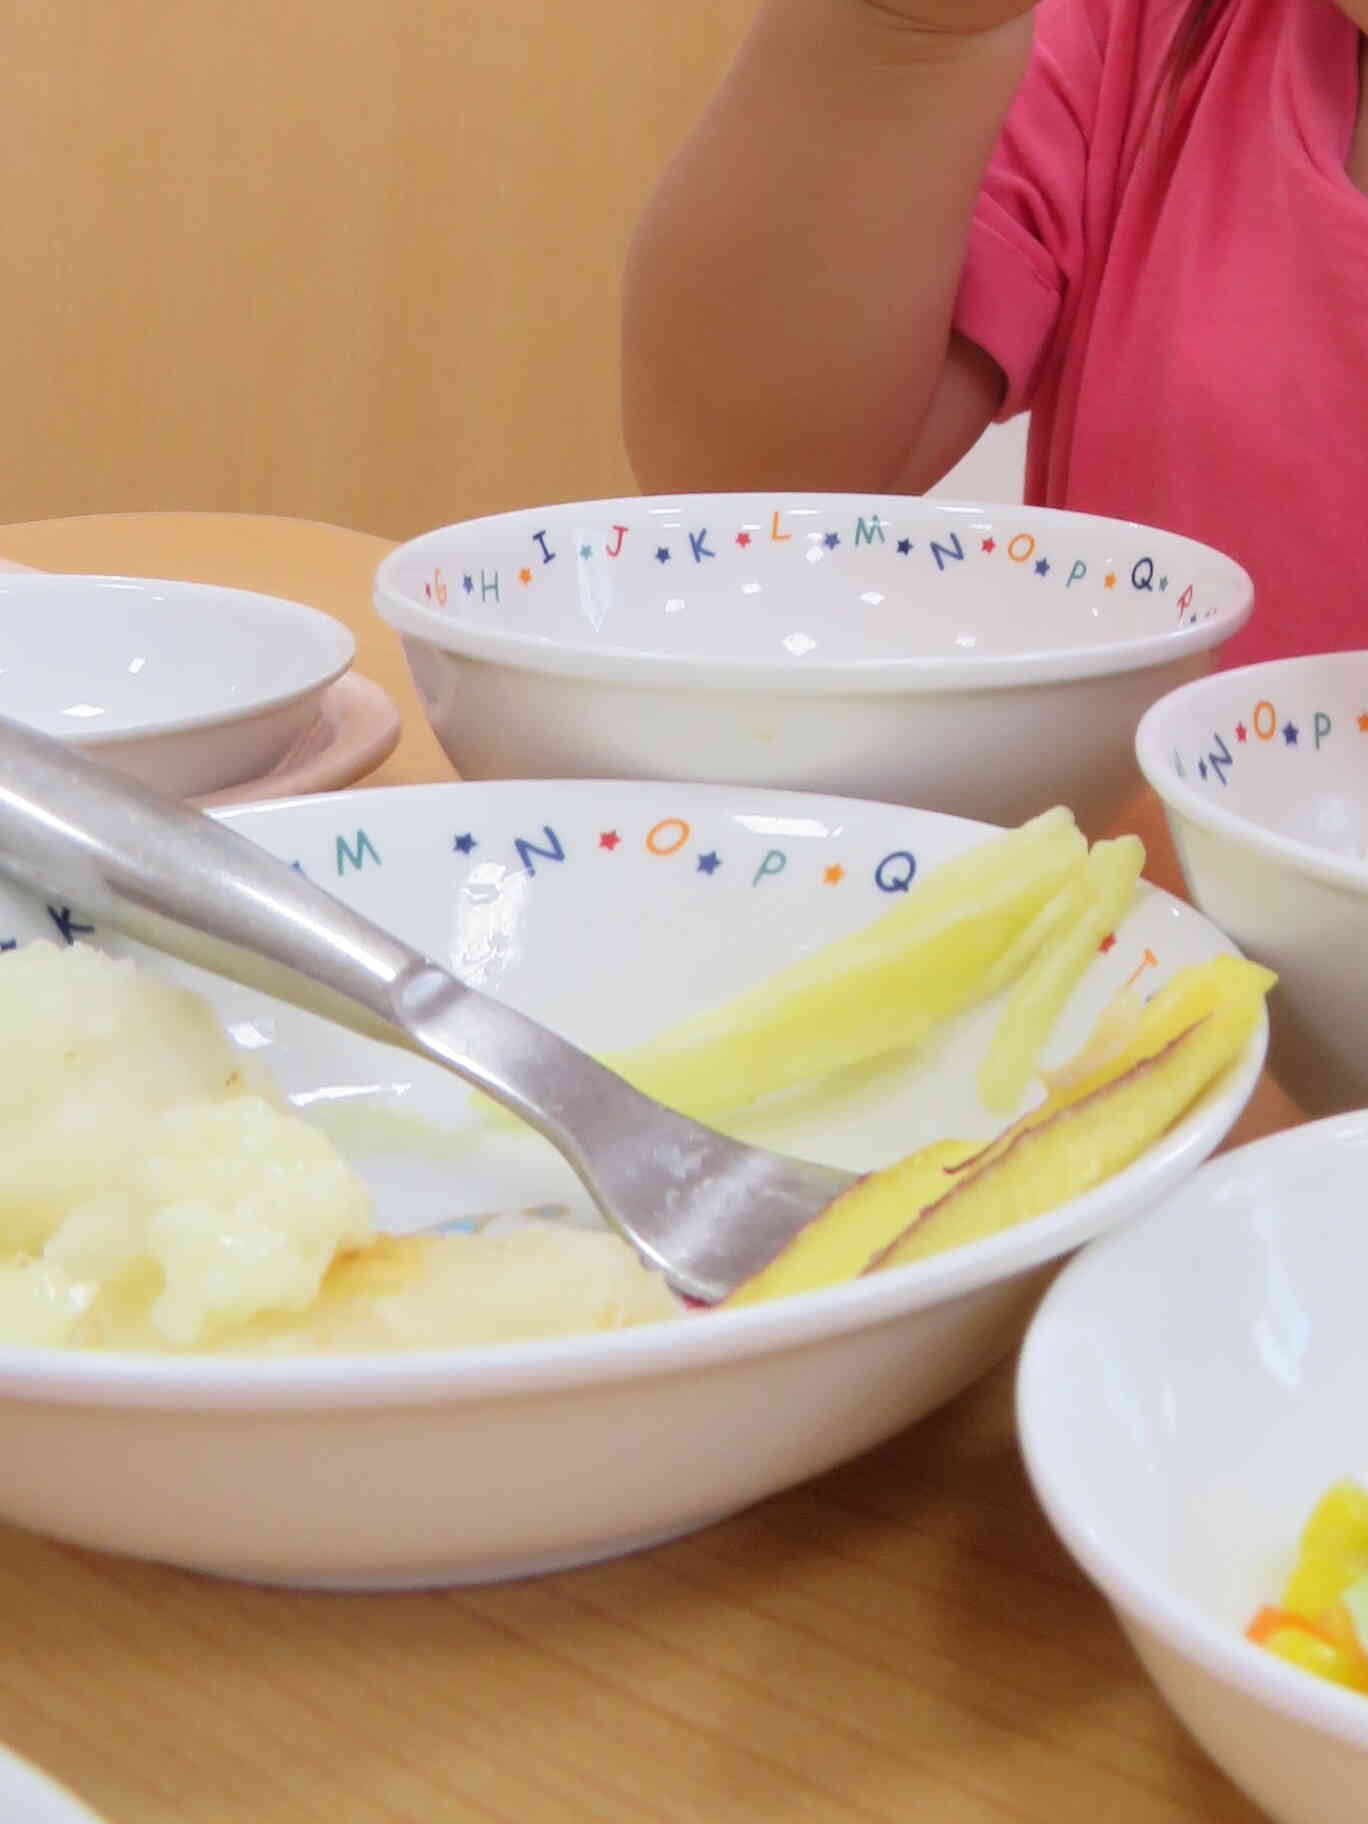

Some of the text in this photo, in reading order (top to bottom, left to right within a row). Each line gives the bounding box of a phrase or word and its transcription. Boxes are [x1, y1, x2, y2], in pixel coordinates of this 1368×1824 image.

[480, 568, 501, 603] H
[532, 530, 557, 565] I
[604, 524, 630, 558] J
[687, 527, 717, 564] K
[769, 509, 792, 544] L
[854, 514, 887, 547] M
[929, 531, 968, 571] N
[1006, 531, 1037, 566] O
[1065, 559, 1088, 589] P
[1130, 555, 1155, 593] Q
[1207, 731, 1234, 787] N
[1250, 699, 1279, 744] O
[1312, 711, 1334, 752] P
[335, 827, 383, 877] M
[512, 823, 568, 879] N
[642, 816, 694, 860] O
[751, 848, 788, 889] P
[873, 849, 918, 895] Q
[1125, 947, 1160, 990] T
